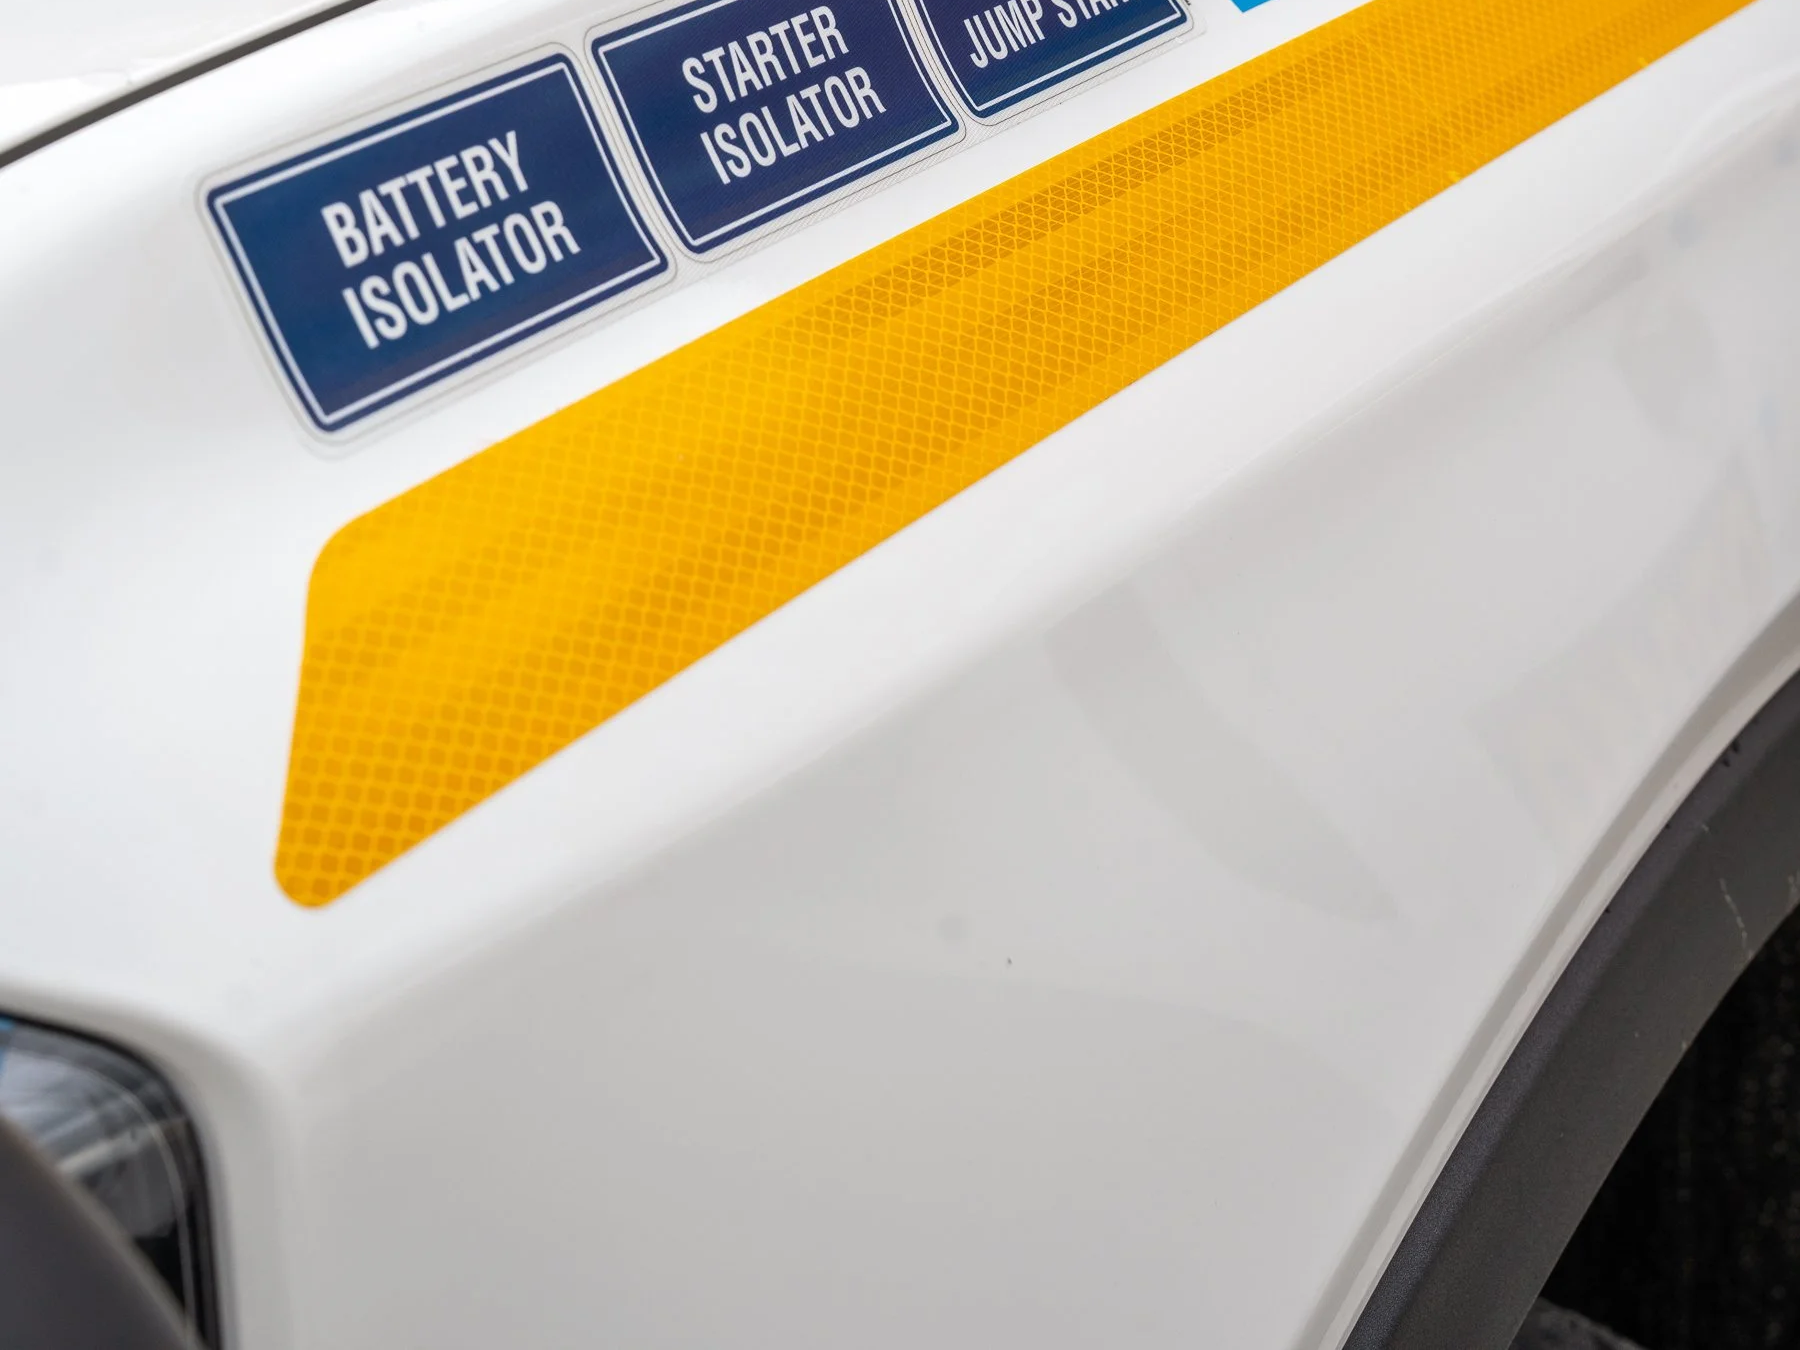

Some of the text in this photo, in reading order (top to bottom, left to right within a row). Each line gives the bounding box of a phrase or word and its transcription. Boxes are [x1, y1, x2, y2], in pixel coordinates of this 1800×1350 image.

[682, 5, 850, 114] STARTER
[700, 66, 887, 185] ISOLATOR
[321, 130, 529, 268] BATTERY
[342, 200, 581, 349] ISOLATOR
